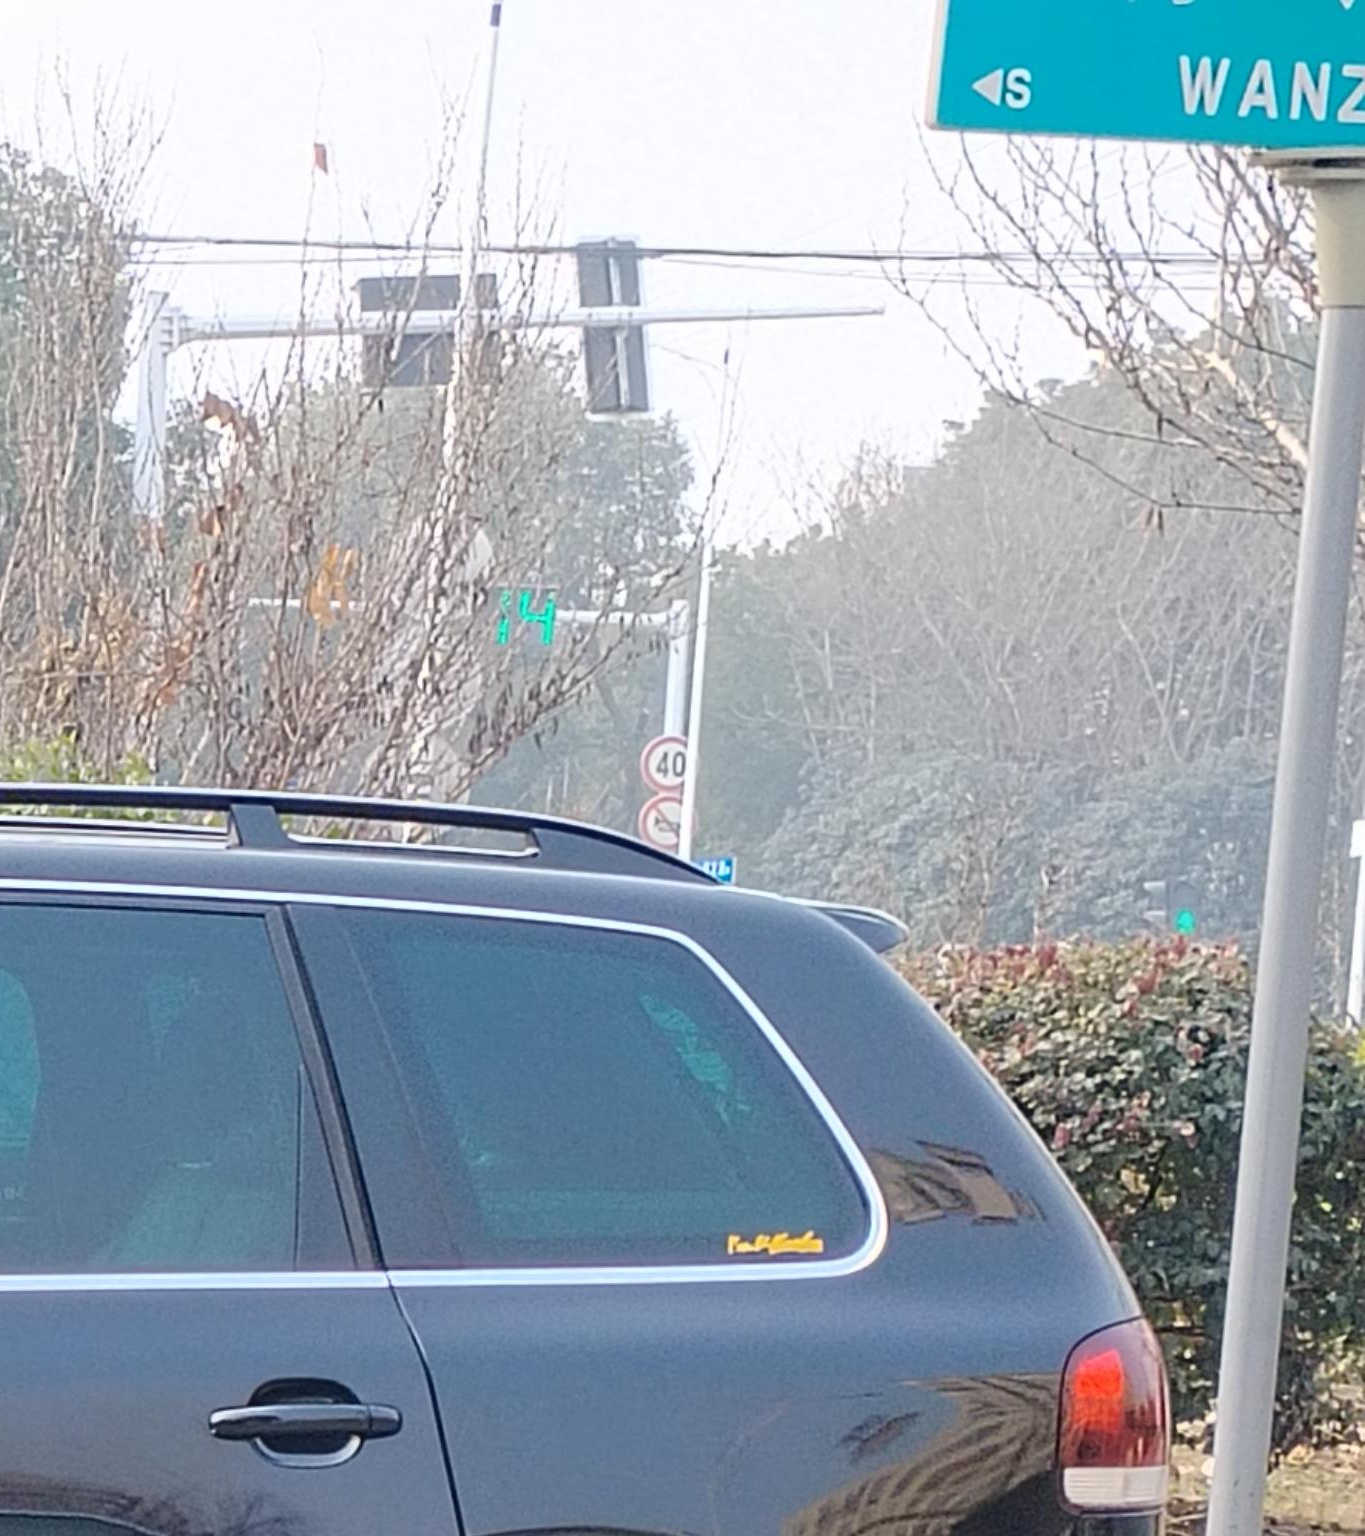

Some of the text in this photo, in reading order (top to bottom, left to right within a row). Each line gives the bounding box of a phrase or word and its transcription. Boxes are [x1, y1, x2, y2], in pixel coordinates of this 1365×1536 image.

[1004, 68, 1032, 109] S
[498, 590, 556, 646] 14
[656, 751, 686, 778] 40
